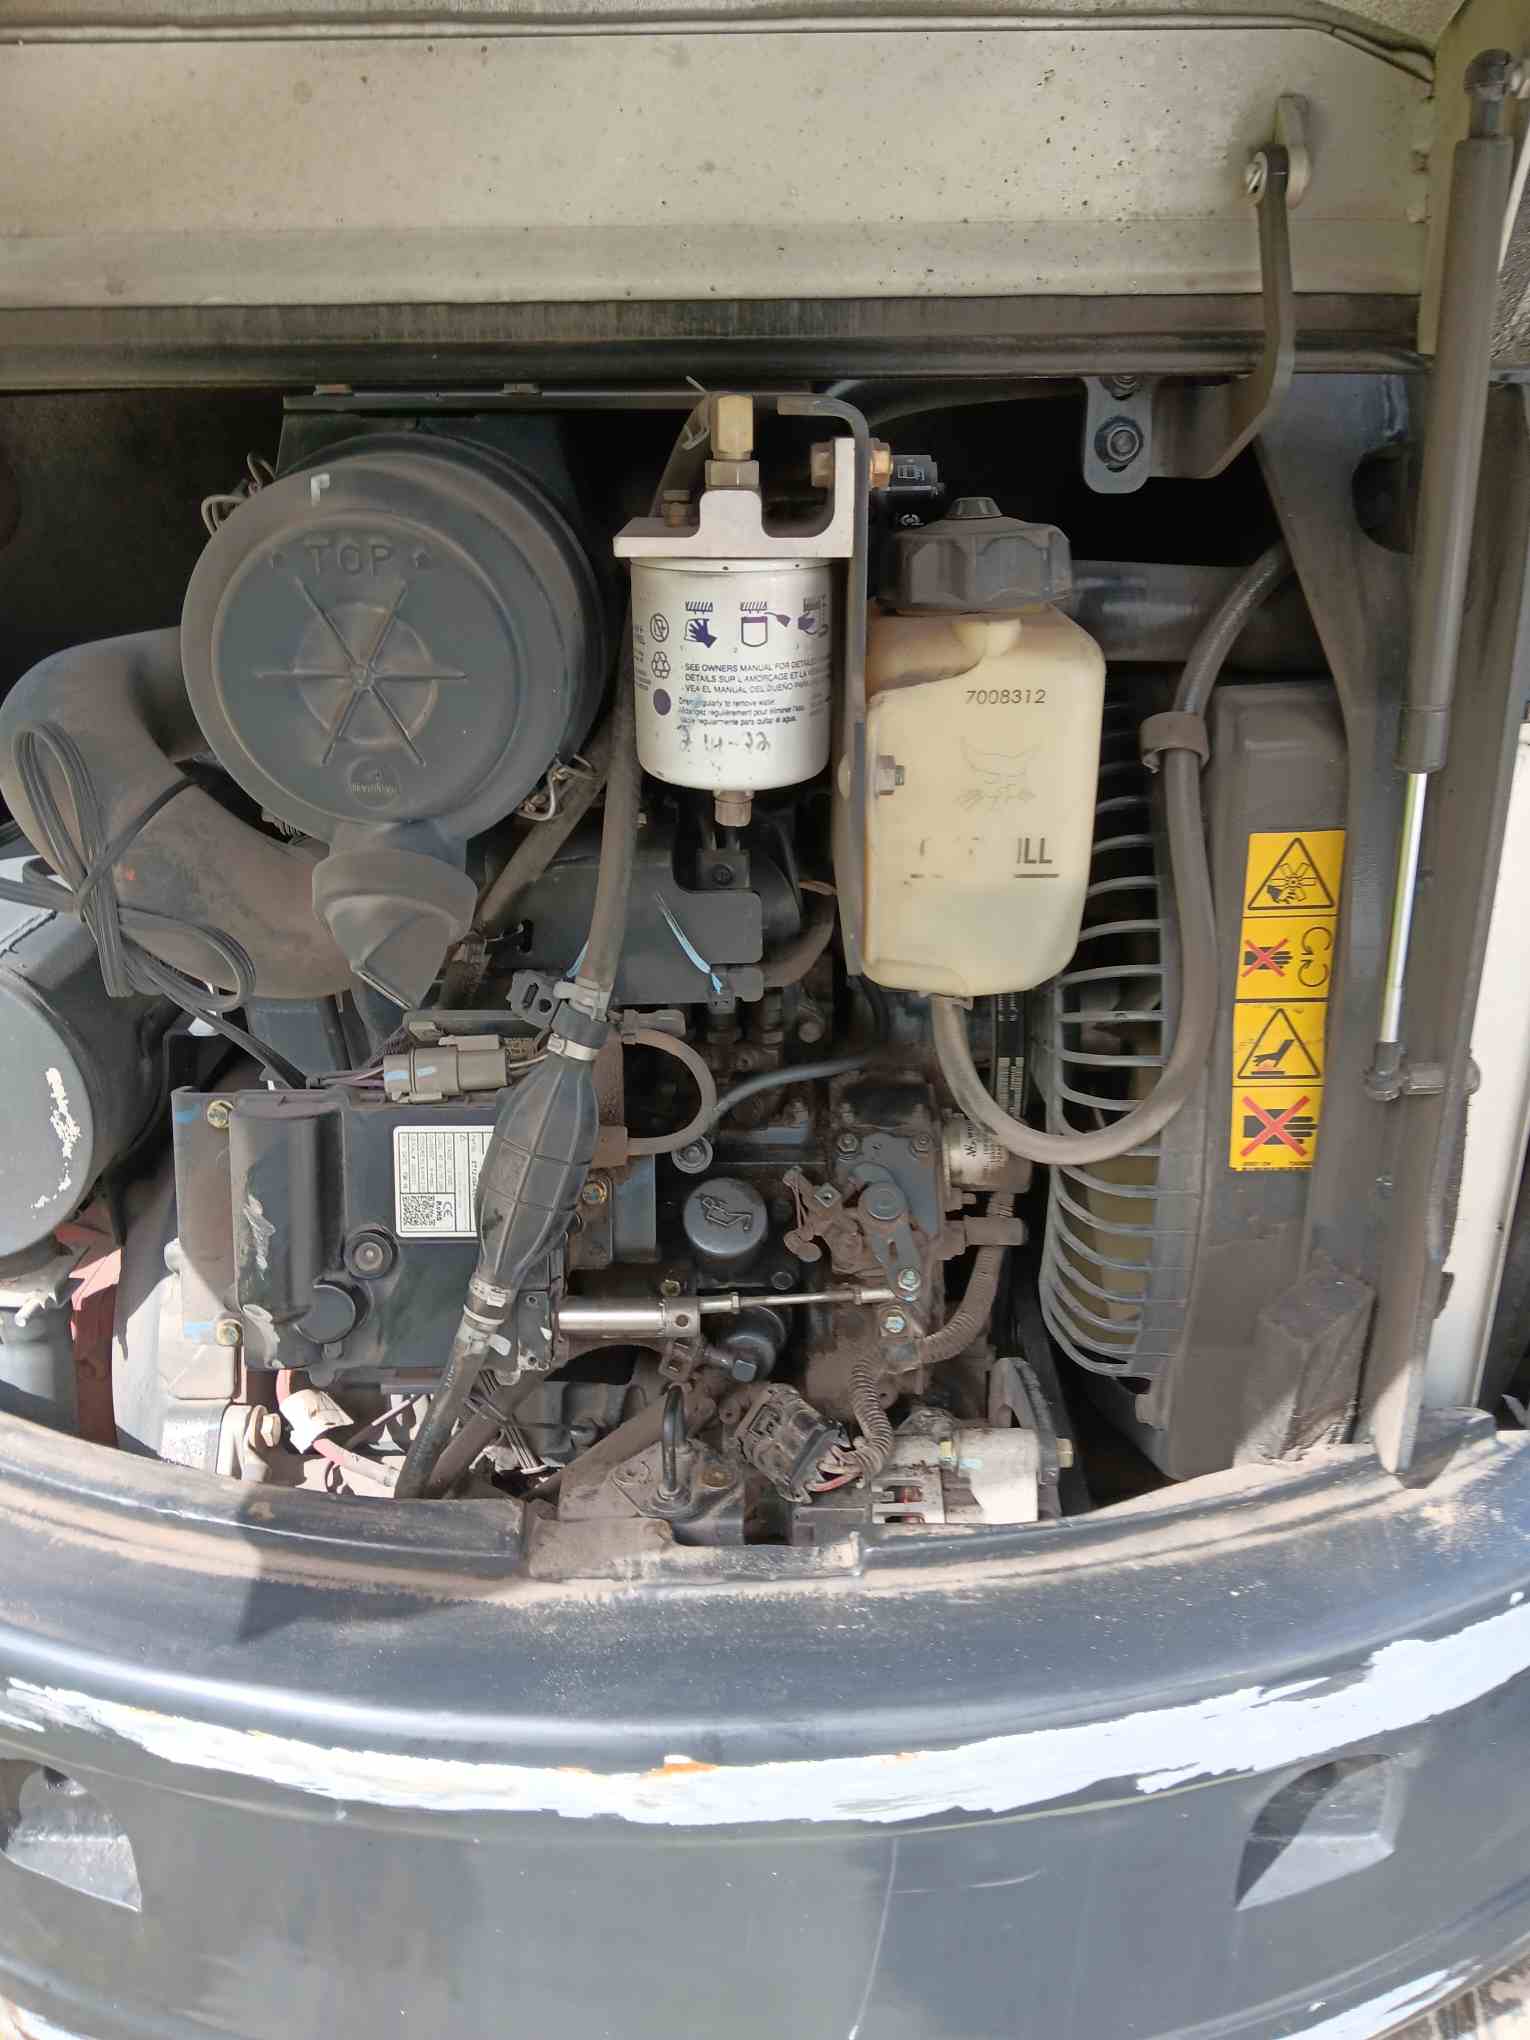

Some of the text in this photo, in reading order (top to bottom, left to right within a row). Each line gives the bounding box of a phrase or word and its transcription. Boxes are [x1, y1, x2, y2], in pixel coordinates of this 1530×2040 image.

[307, 541, 394, 577] TOP
[685, 663, 700, 671] SEE
[701, 664, 738, 672] OWNERS
[740, 662, 773, 671] MANUAL
[702, 685, 713, 693] EL
[714, 686, 748, 695] MANUAL
[964, 688, 1047, 705] 7008312
